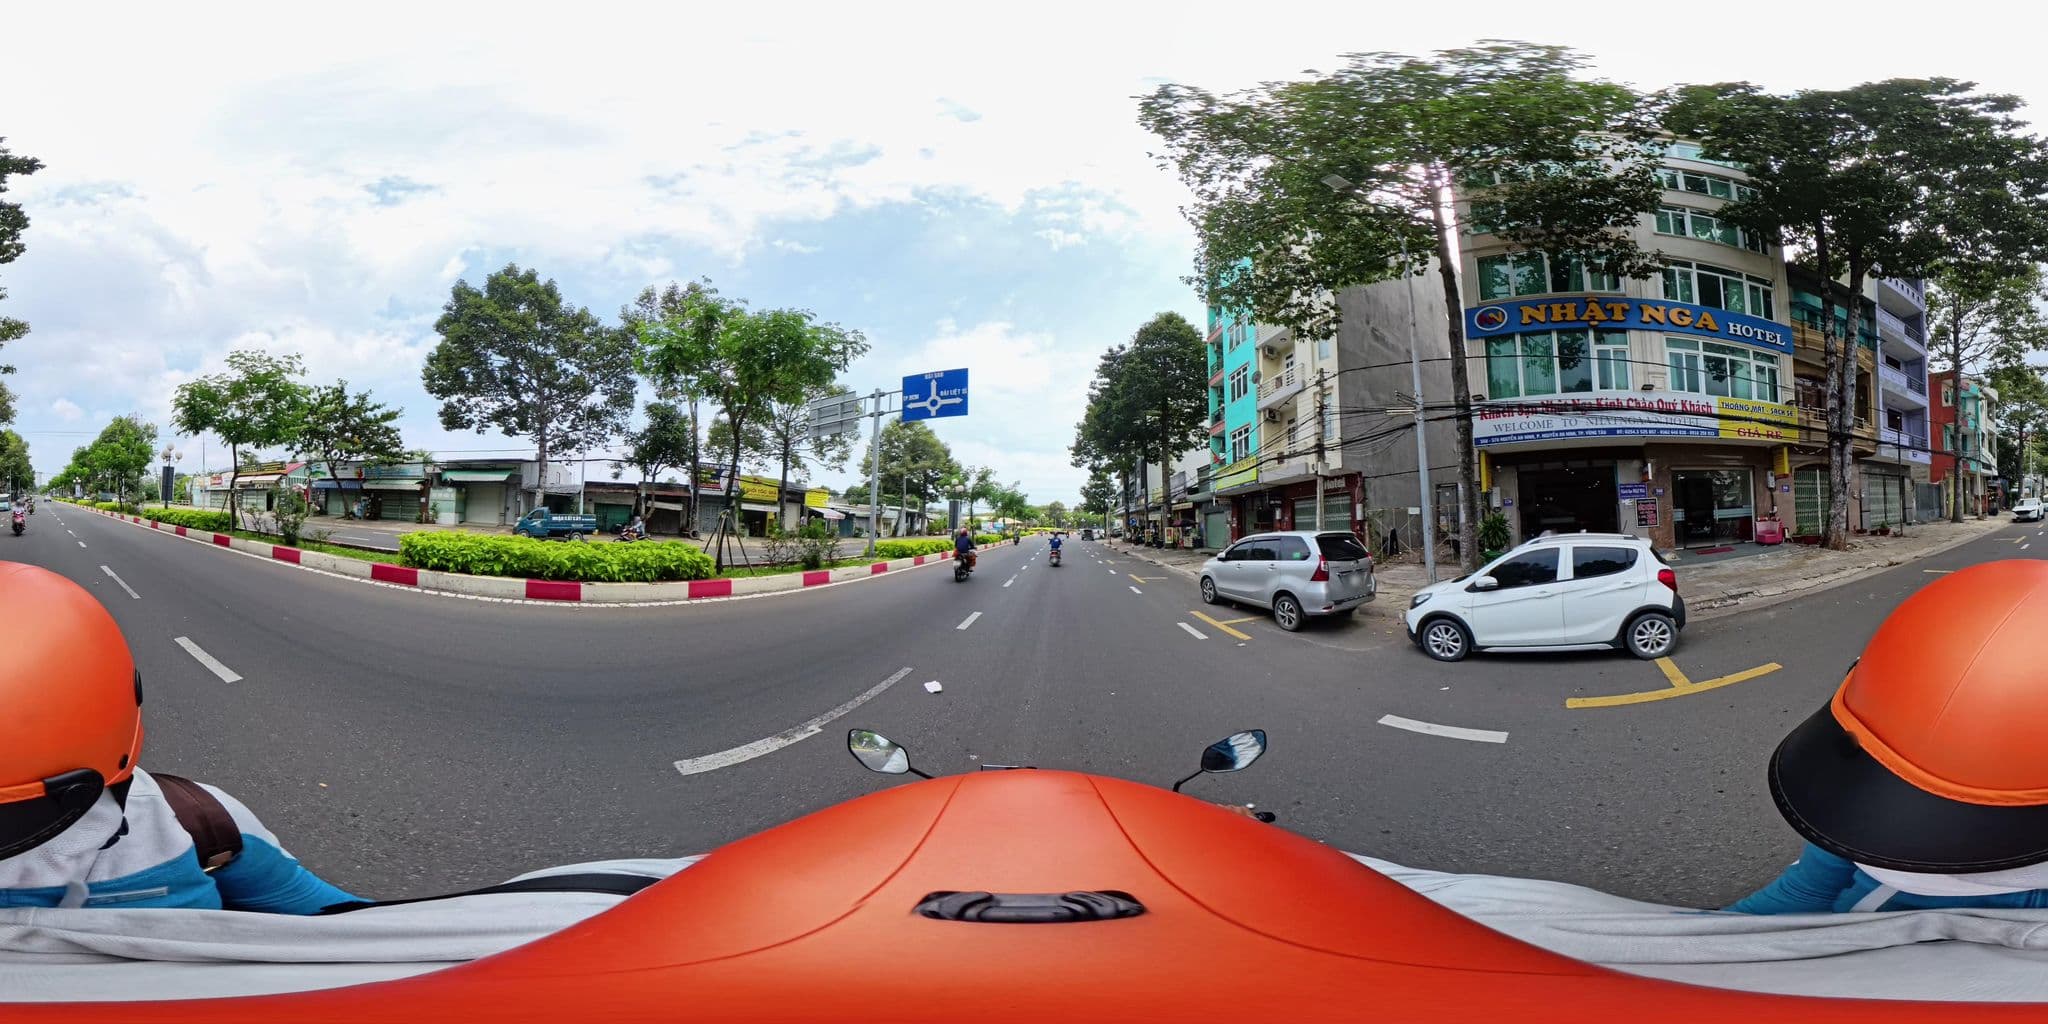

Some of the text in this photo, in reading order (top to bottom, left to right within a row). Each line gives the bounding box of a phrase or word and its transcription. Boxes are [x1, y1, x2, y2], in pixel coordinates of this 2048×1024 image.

[1519, 297, 1786, 346] NHẬT NGA HOTEL
[1626, 396, 1655, 411] Chào
[1656, 397, 1678, 412] Quý
[1680, 398, 1713, 415] Khách
[1493, 419, 1554, 433] WELCOME
[1561, 417, 1578, 428] TO
[1737, 426, 1761, 438] GIÁ
